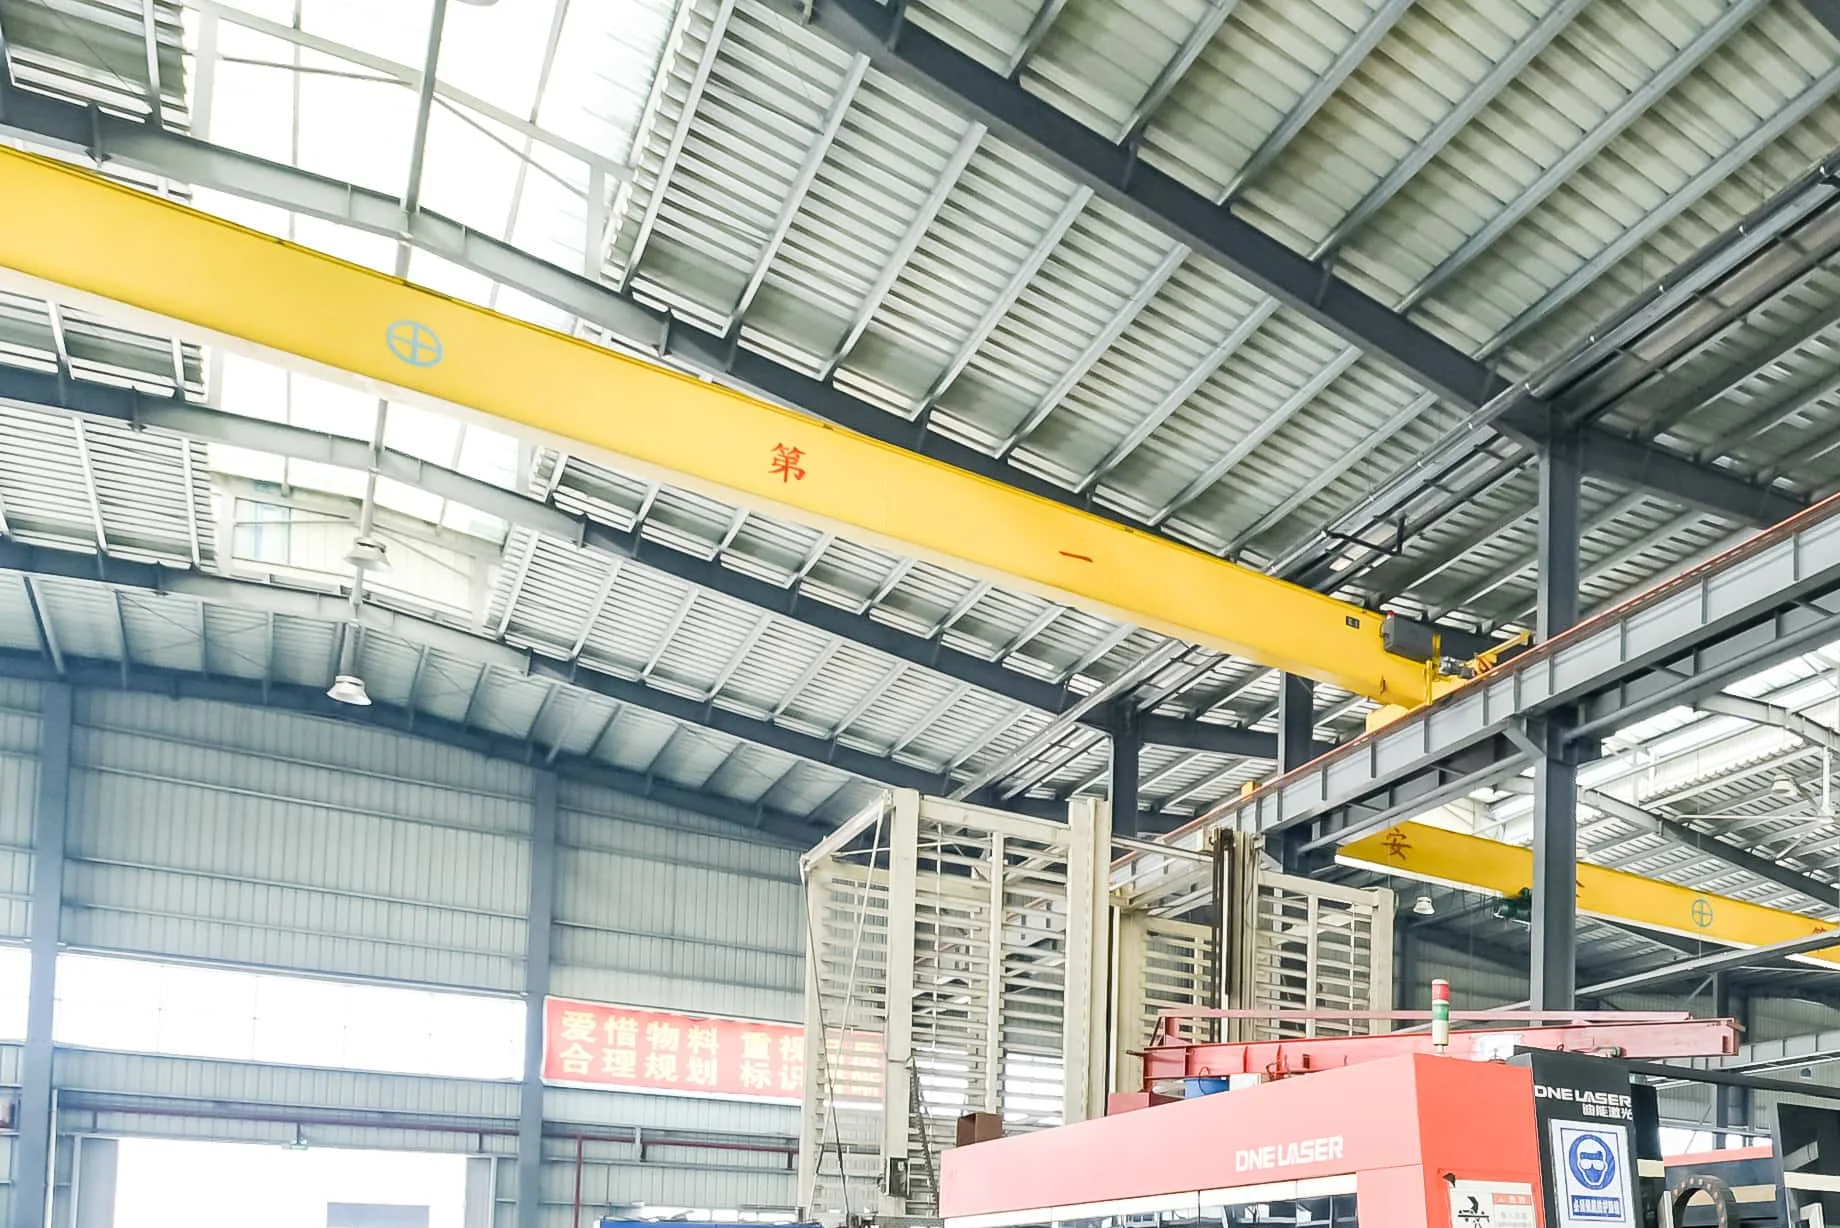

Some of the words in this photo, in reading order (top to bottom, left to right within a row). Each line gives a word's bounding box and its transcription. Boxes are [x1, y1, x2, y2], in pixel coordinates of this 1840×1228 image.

[768, 442, 806, 483] 第
[1381, 829, 1411, 861] 安
[560, 1010, 719, 1056] 爱惜物料
[559, 1043, 718, 1086] 合理规划
[1574, 1089, 1633, 1107] LASER
[1277, 1134, 1344, 1167] LASER
